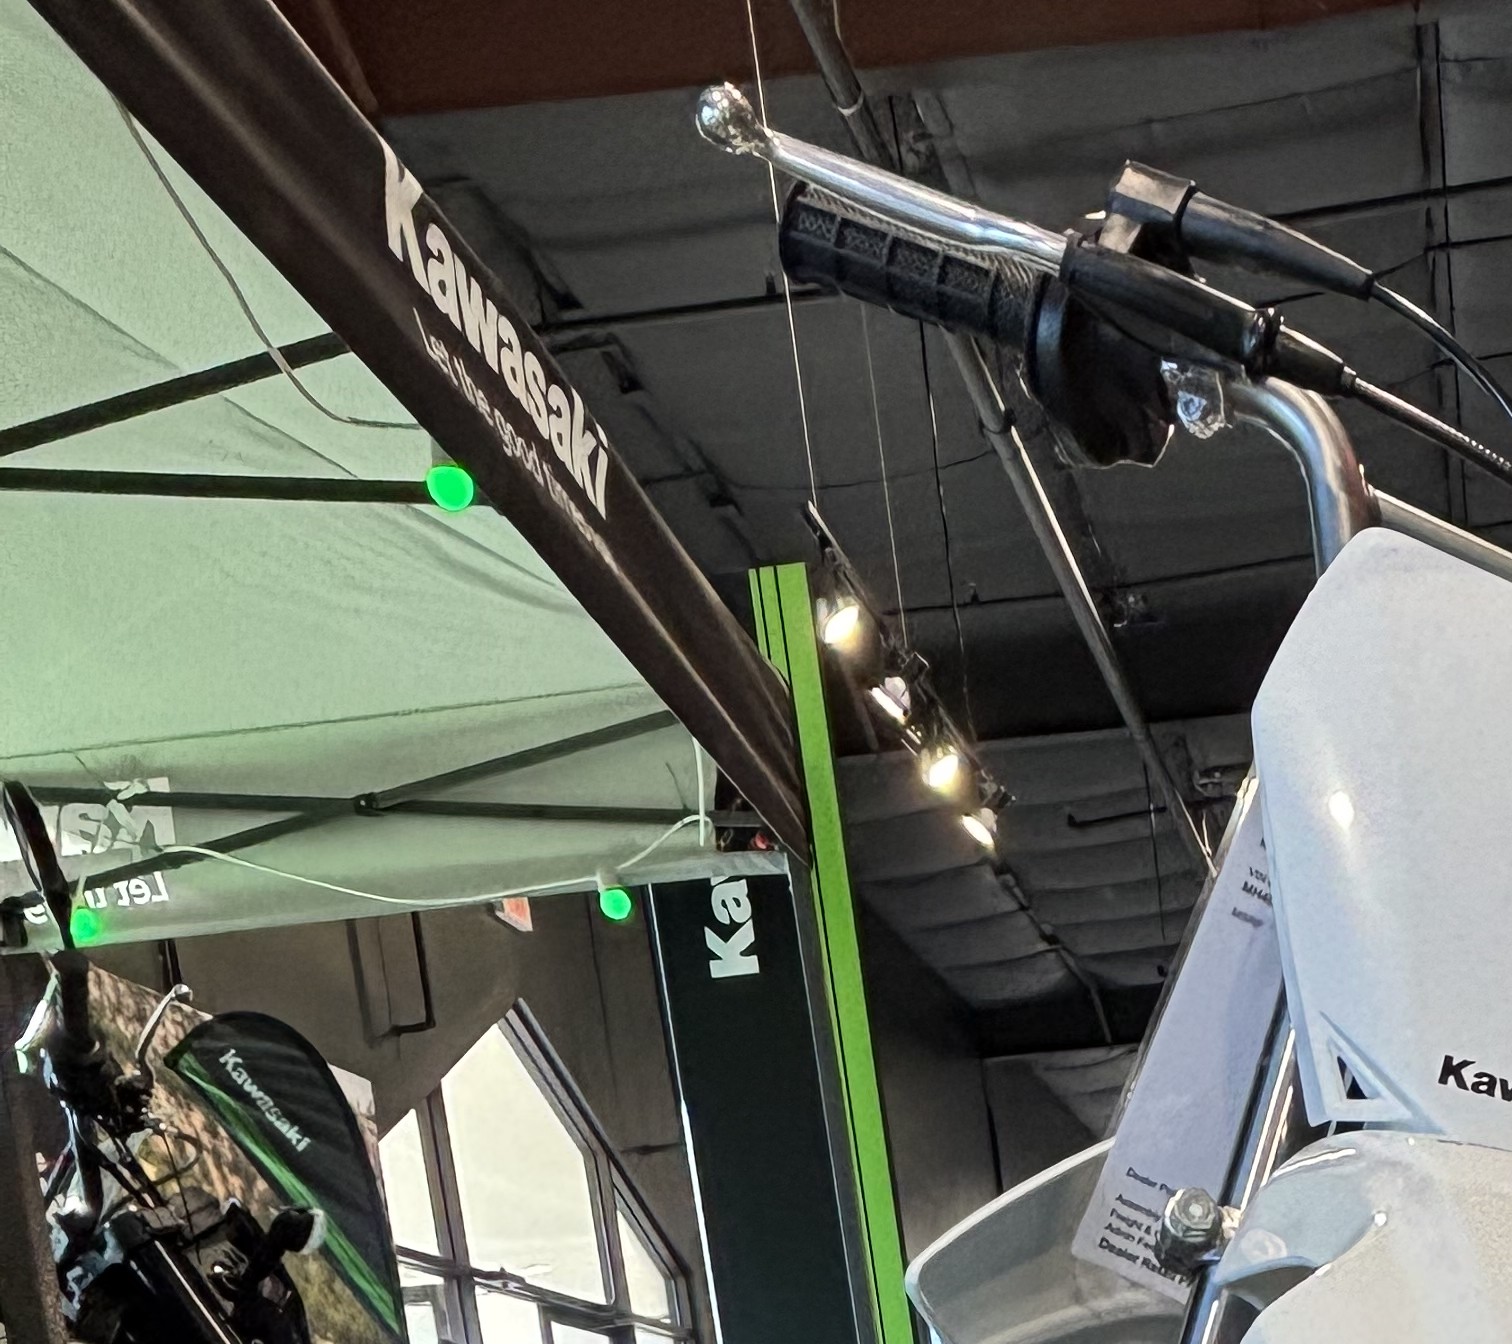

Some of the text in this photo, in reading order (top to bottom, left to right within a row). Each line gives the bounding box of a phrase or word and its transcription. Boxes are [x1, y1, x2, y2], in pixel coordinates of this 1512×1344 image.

[379, 134, 608, 520] Kawasaki
[703, 875, 760, 979] Ka
[218, 1048, 312, 1152] Kawasaki
[1098, 1236, 1140, 1263] Dealer
